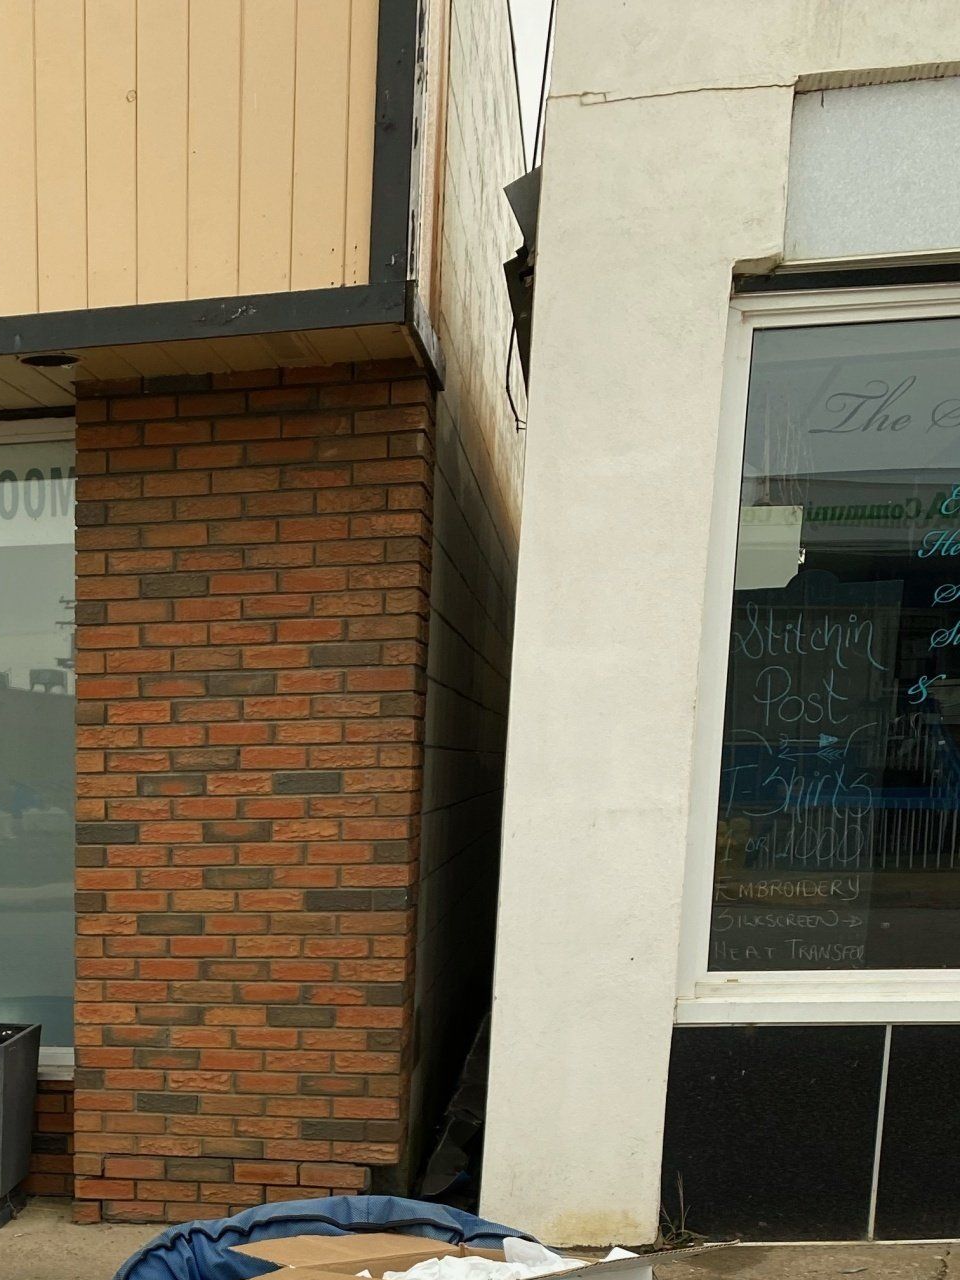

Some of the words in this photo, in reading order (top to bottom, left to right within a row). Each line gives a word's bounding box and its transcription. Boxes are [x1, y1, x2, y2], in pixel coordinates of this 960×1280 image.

[808, 375, 917, 434] The
[732, 601, 888, 671] Stitchin
[753, 665, 848, 726] Post
[715, 874, 860, 901] EMBROIDERY
